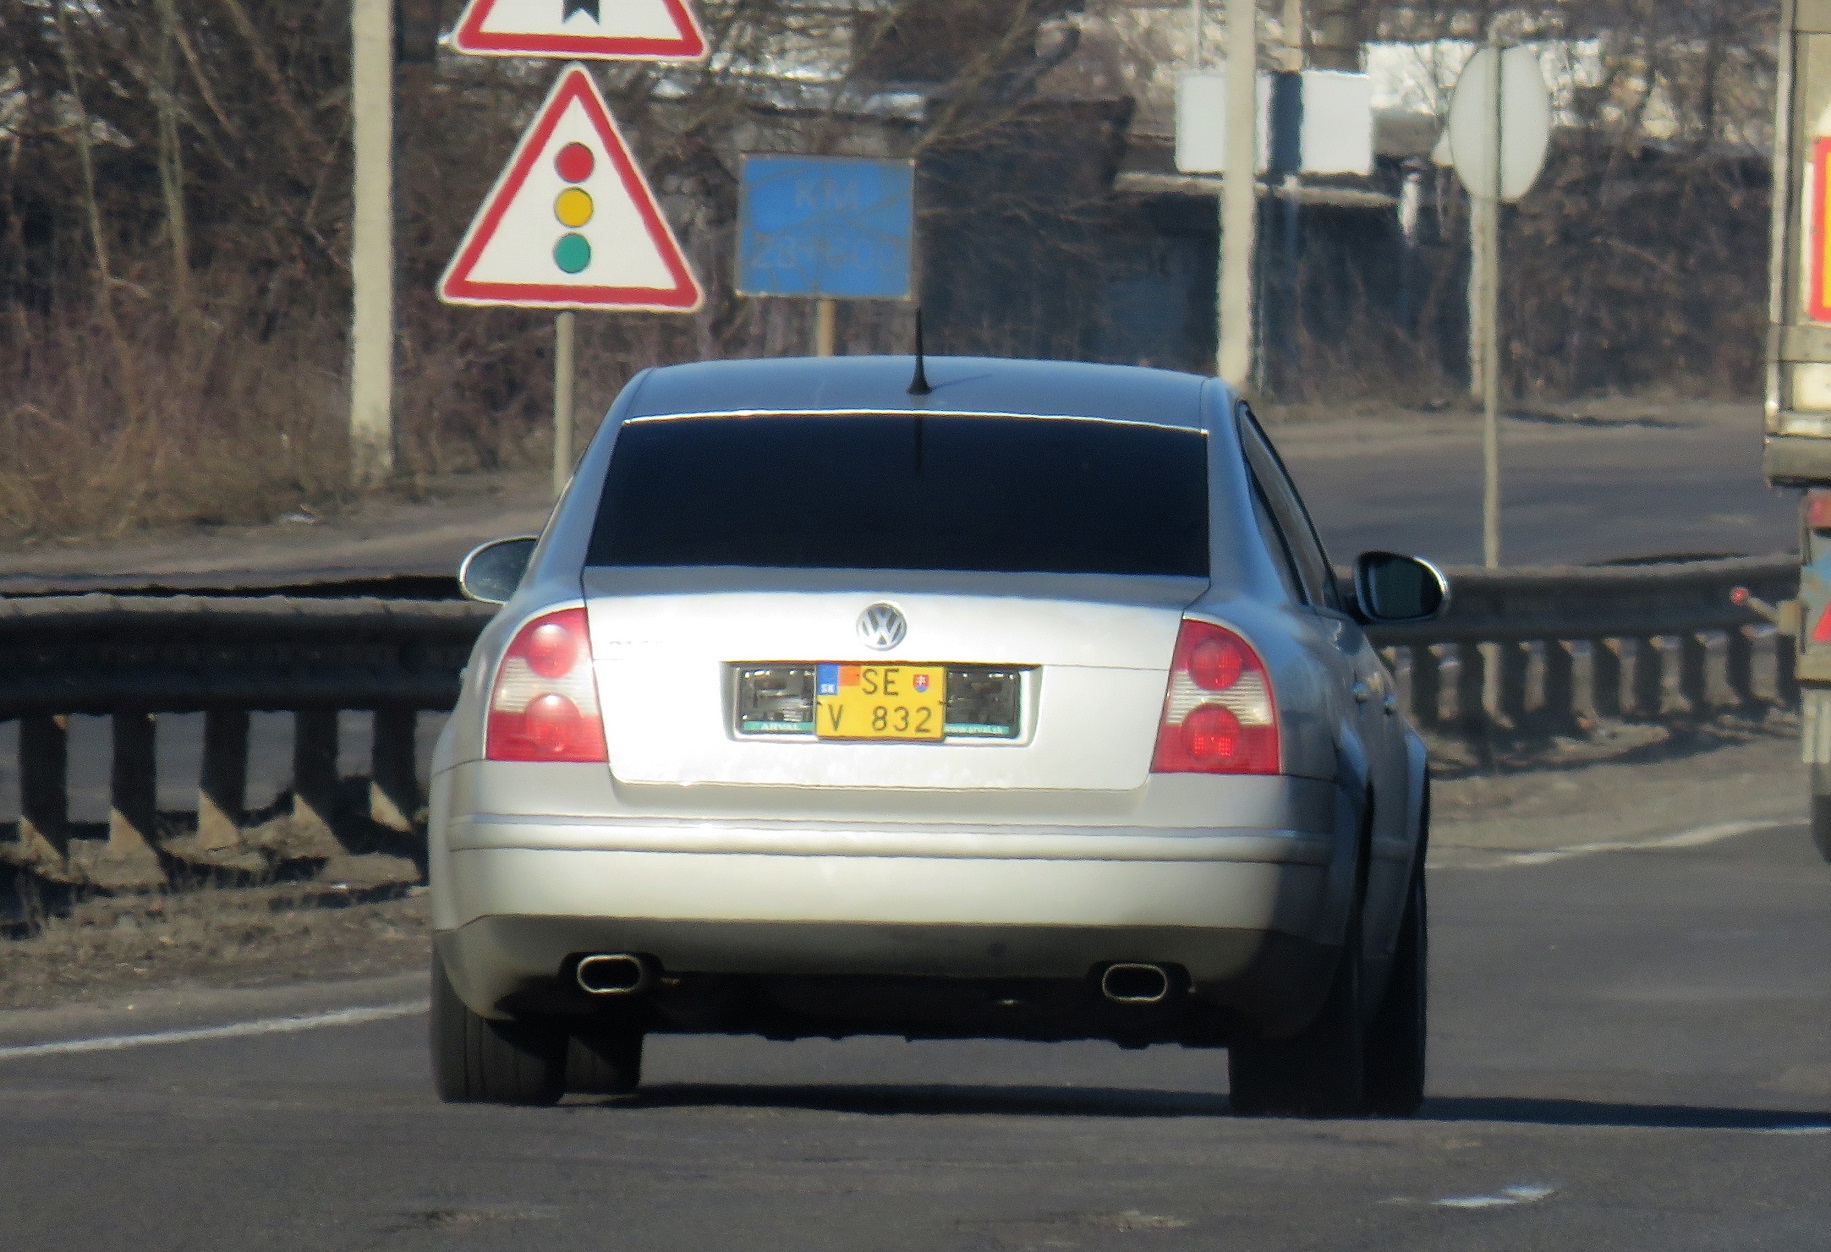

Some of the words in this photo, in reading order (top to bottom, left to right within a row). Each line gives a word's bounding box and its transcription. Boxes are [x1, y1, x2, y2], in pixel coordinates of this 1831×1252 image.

[862, 668, 899, 696] SE
[828, 704, 843, 731] V
[872, 706, 932, 732] 832
